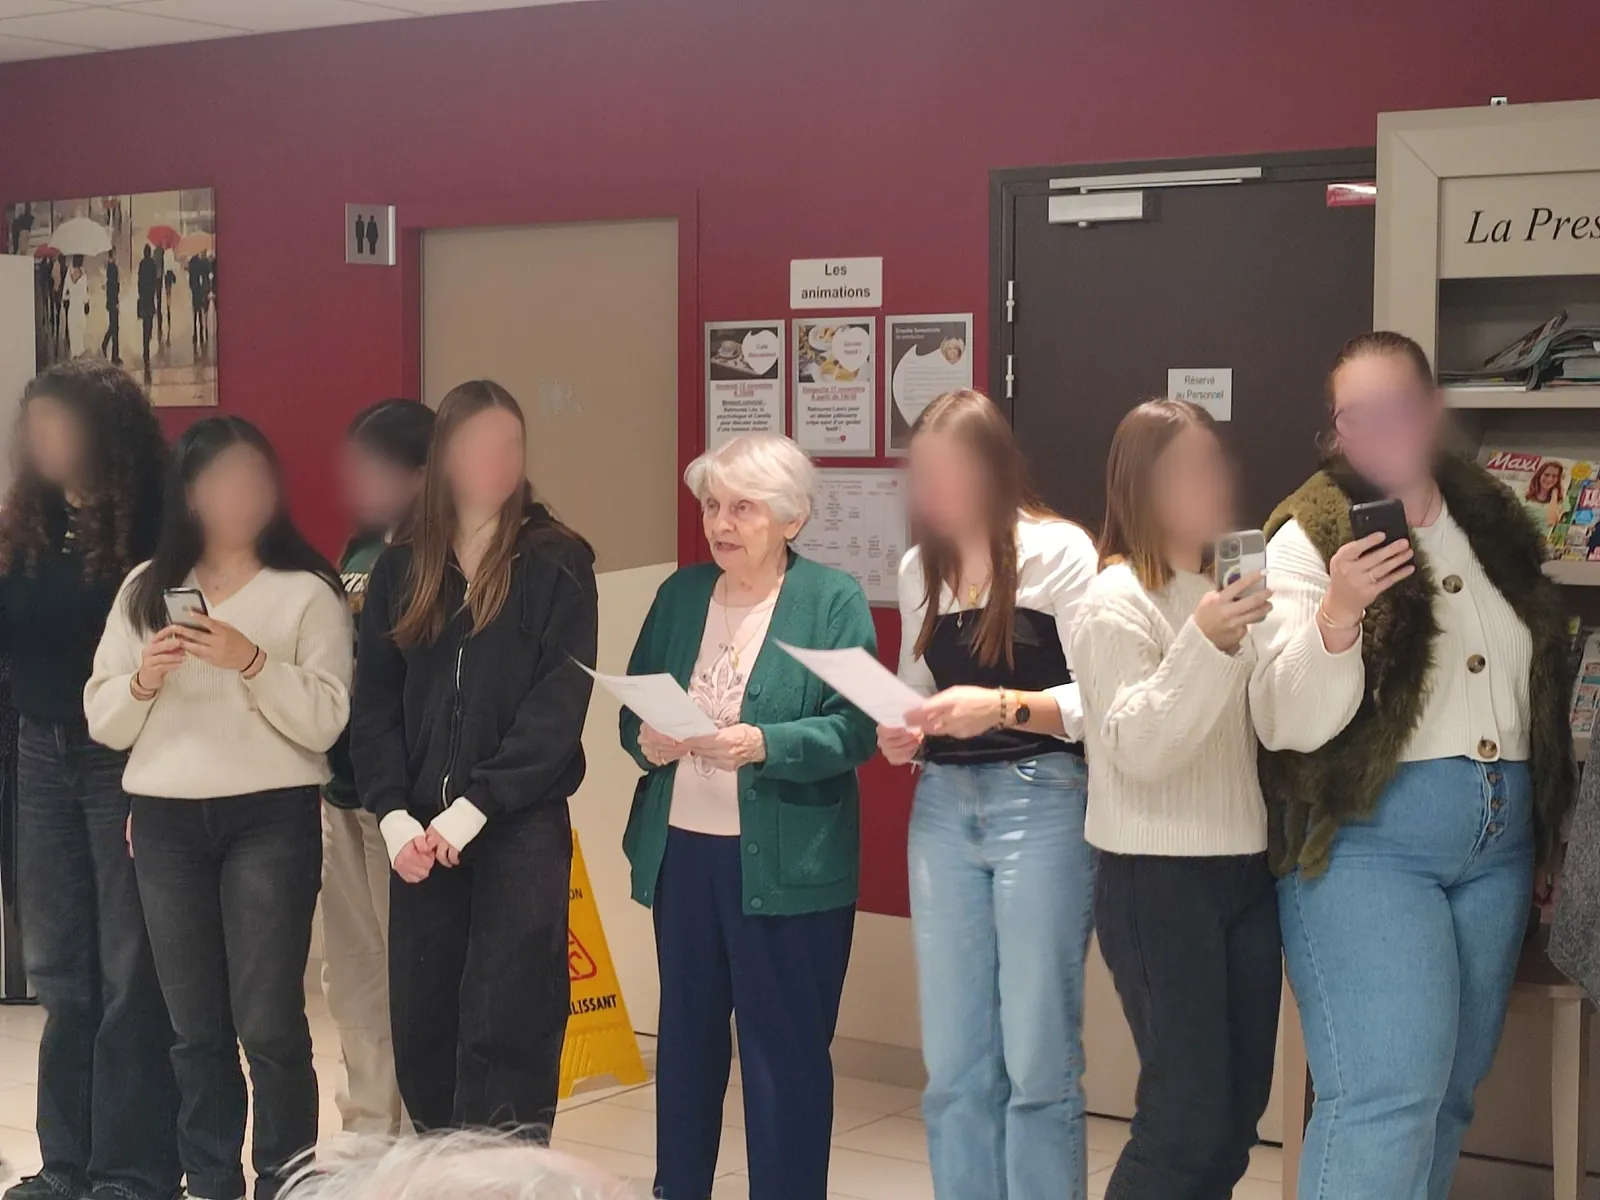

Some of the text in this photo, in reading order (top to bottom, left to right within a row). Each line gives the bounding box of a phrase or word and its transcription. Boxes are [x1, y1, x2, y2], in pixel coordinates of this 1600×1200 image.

[1464, 210, 1512, 244] La
[824, 263, 847, 276] Les
[801, 286, 870, 299] animations
[1187, 389, 1224, 400] Personnel
[1487, 452, 1540, 473] Maxi
[569, 994, 617, 1015] LISSANT
